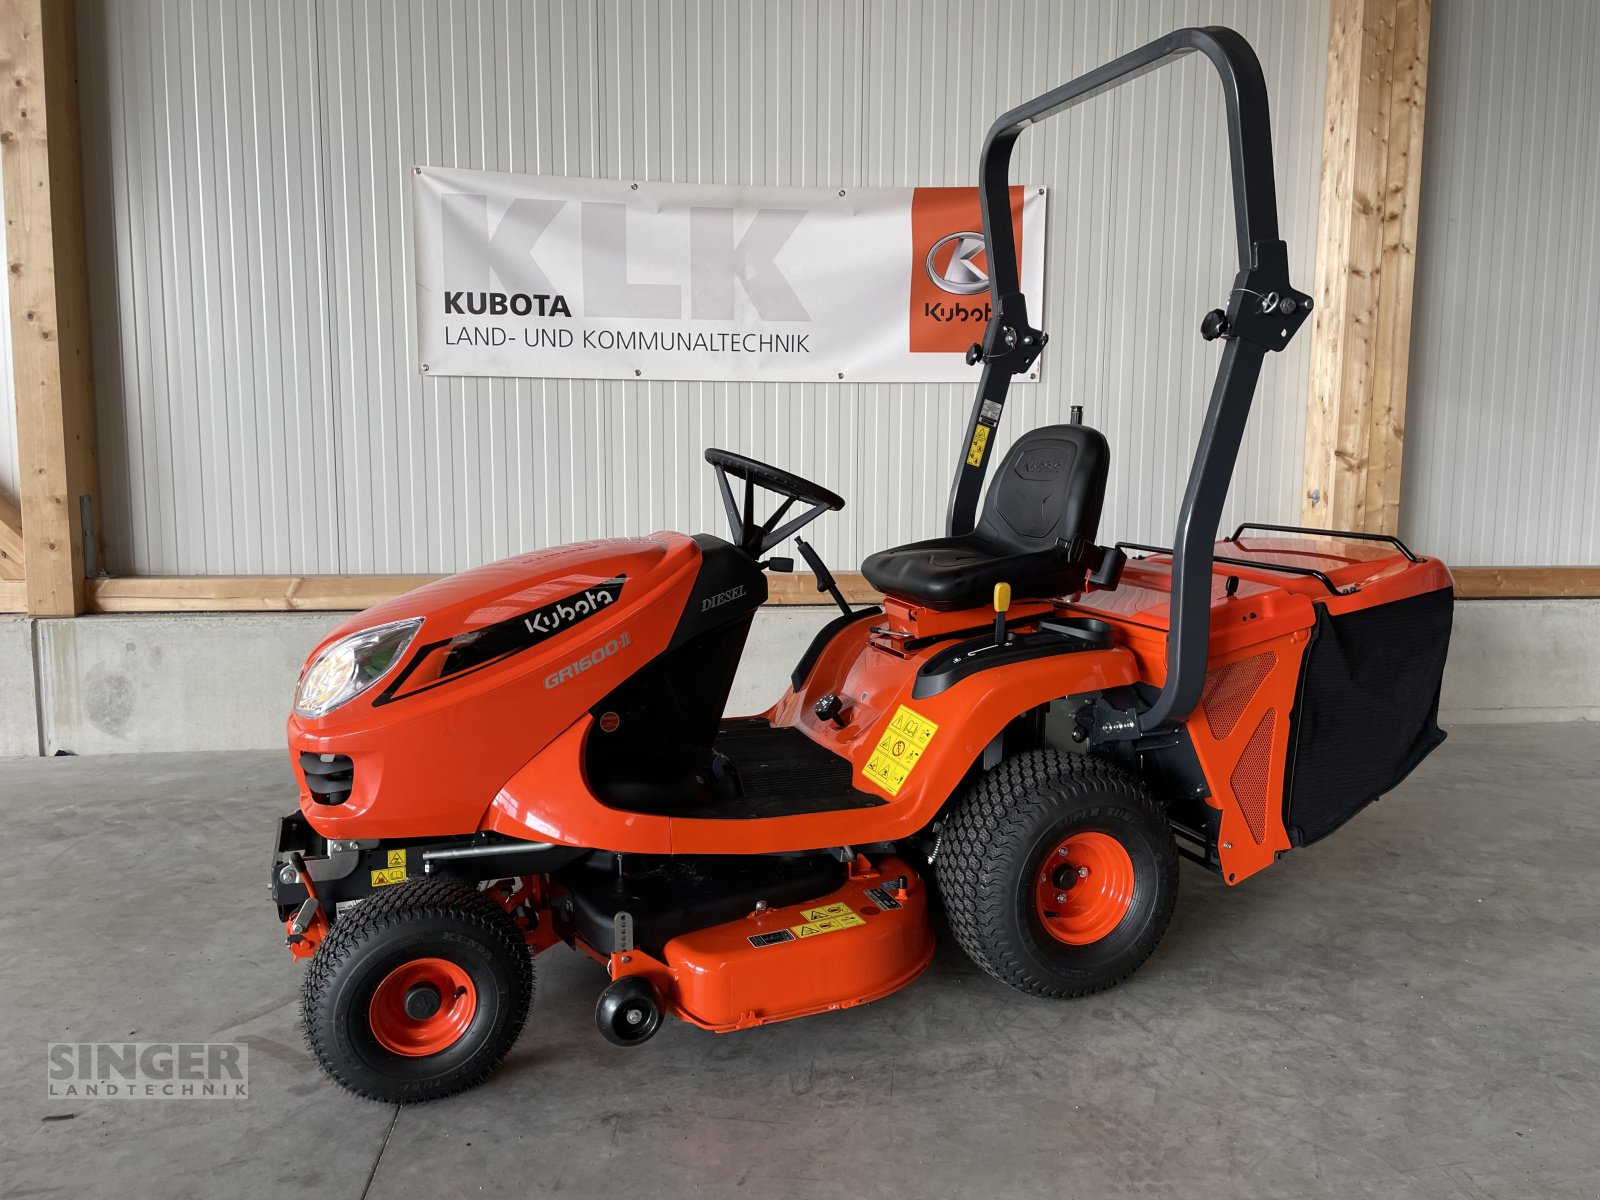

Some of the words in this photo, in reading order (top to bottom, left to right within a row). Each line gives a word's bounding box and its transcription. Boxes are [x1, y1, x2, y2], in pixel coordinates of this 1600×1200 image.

[441, 193, 812, 321] KLK
[444, 291, 572, 317] KUBOTA
[925, 302, 992, 322] Kubot
[445, 326, 516, 346] LAND-
[524, 328, 574, 348] UND
[583, 330, 810, 353] KOMMUNALTECHNIK
[524, 590, 613, 634] Kubota
[701, 585, 747, 612] DIESEL
